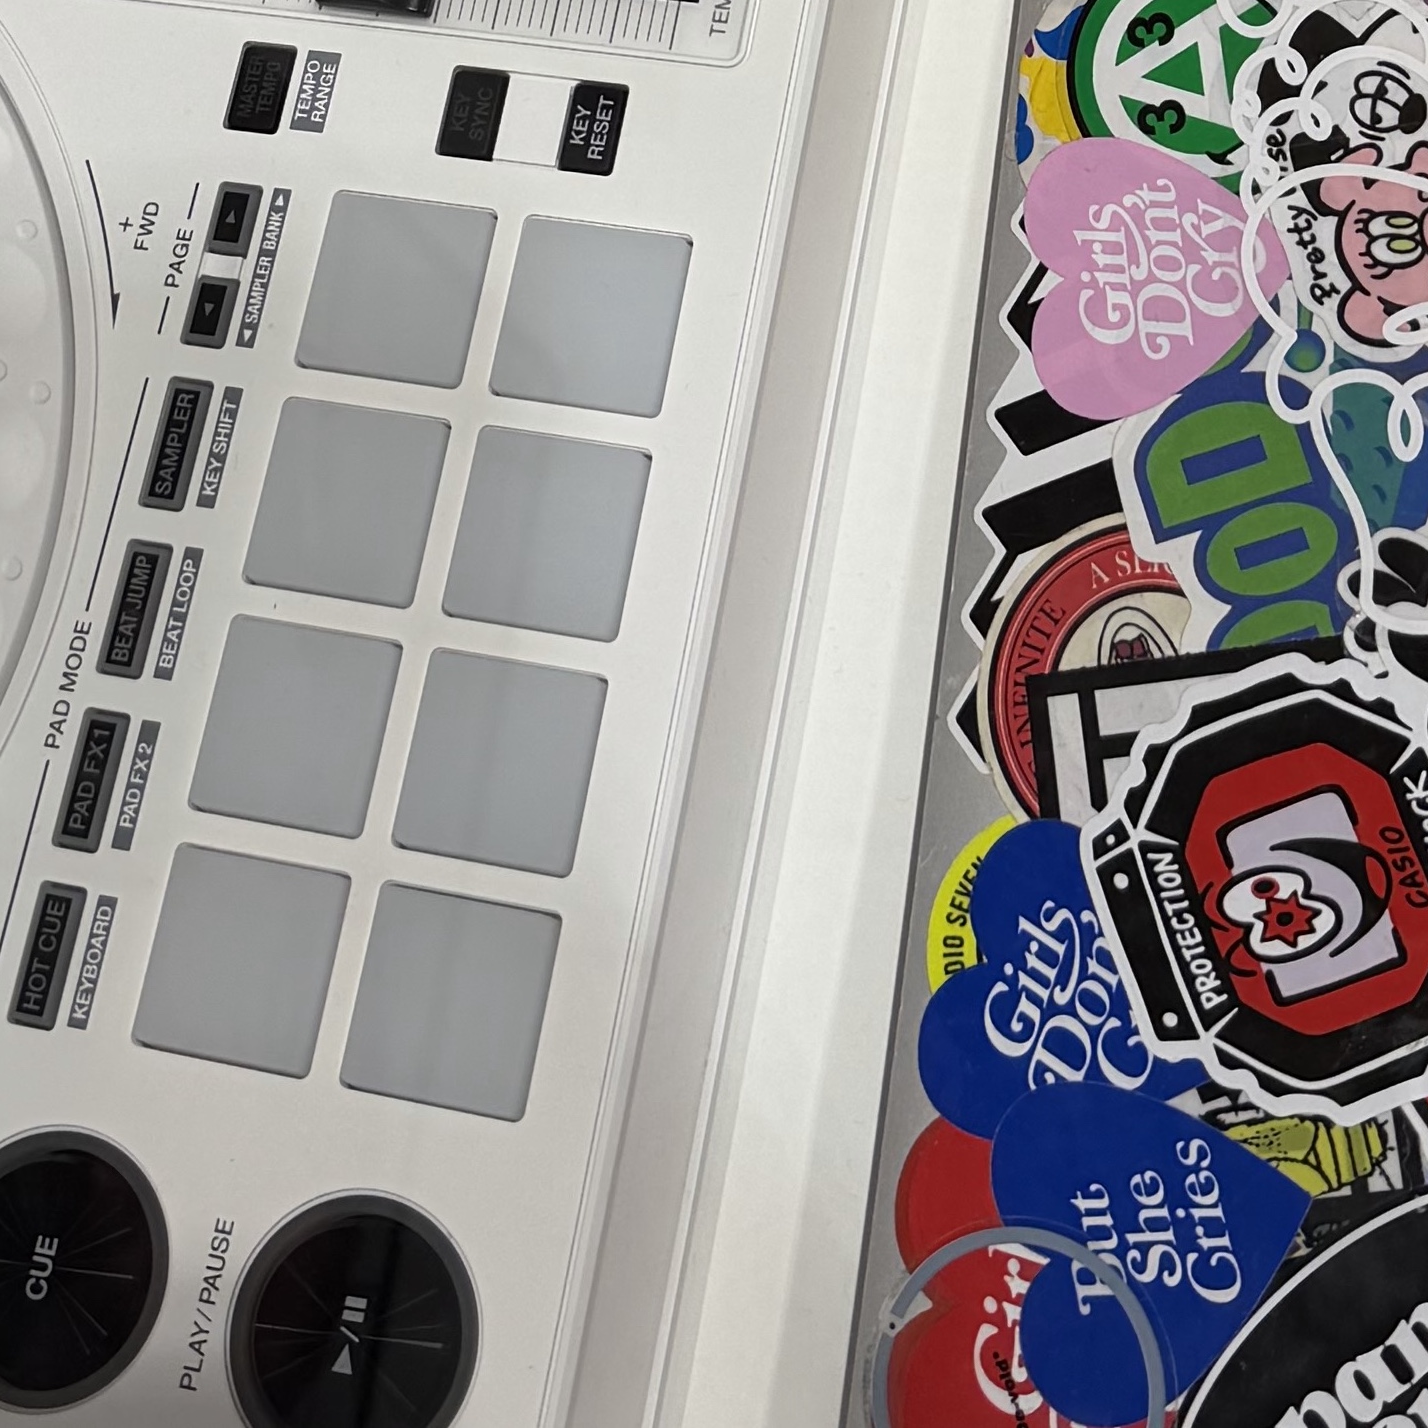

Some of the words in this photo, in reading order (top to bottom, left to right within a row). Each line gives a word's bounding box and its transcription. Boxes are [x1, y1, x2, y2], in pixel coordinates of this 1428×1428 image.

[1126, 11, 1175, 48] 3
[568, 104, 593, 145] KEY
[585, 93, 617, 161] RESET
[1136, 98, 1187, 136] 3
[133, 200, 161, 251] FWD
[163, 227, 194, 290] PAGE
[1182, 198, 1267, 318] Cry
[1287, 205, 1340, 306] Pretty
[1074, 199, 1140, 345] Girls
[212, 397, 239, 451] SHIFT
[202, 455, 229, 497] KEY
[43, 699, 71, 750] PAD
[59, 619, 92, 692] MODE
[37, 898, 68, 952] CUE
[1146, 852, 1228, 1010] PROTECTION
[22, 957, 54, 1011] HOT
[71, 905, 114, 1021] KEYBOARD
[984, 900, 1079, 1057] Girls
[1071, 1183, 1123, 1316] But
[1122, 1170, 1178, 1288] She
[24, 1235, 60, 1302] CUE
[178, 1216, 235, 1393] PLAY/PAUSE
